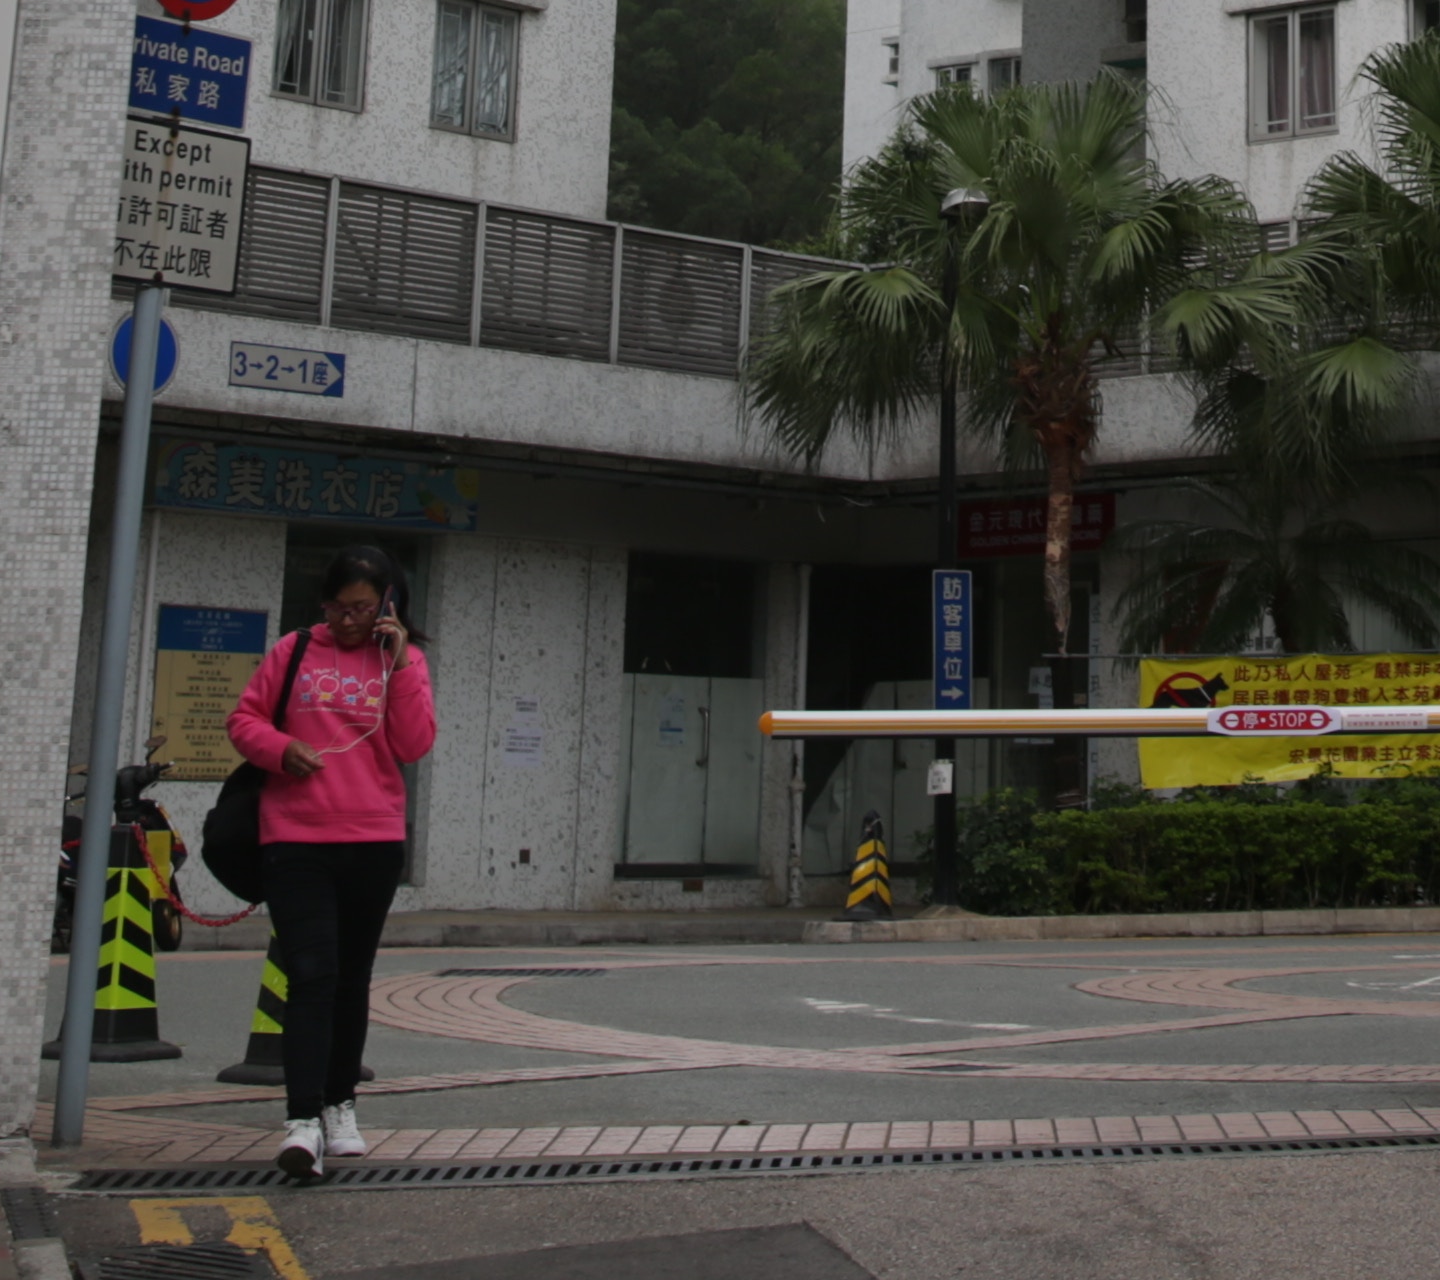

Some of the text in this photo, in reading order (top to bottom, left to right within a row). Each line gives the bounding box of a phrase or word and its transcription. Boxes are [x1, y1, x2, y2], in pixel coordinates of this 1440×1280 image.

[133, 33, 245, 76] rivate Road
[135, 66, 220, 109] 私家路
[133, 128, 212, 167] Except
[123, 158, 234, 198] ith permit
[114, 236, 212, 279] 不在此限
[178, 449, 405, 519] 森美洗衣店
[941, 576, 964, 681] 訪客車位
[1268, 712, 1308, 729] STOP
